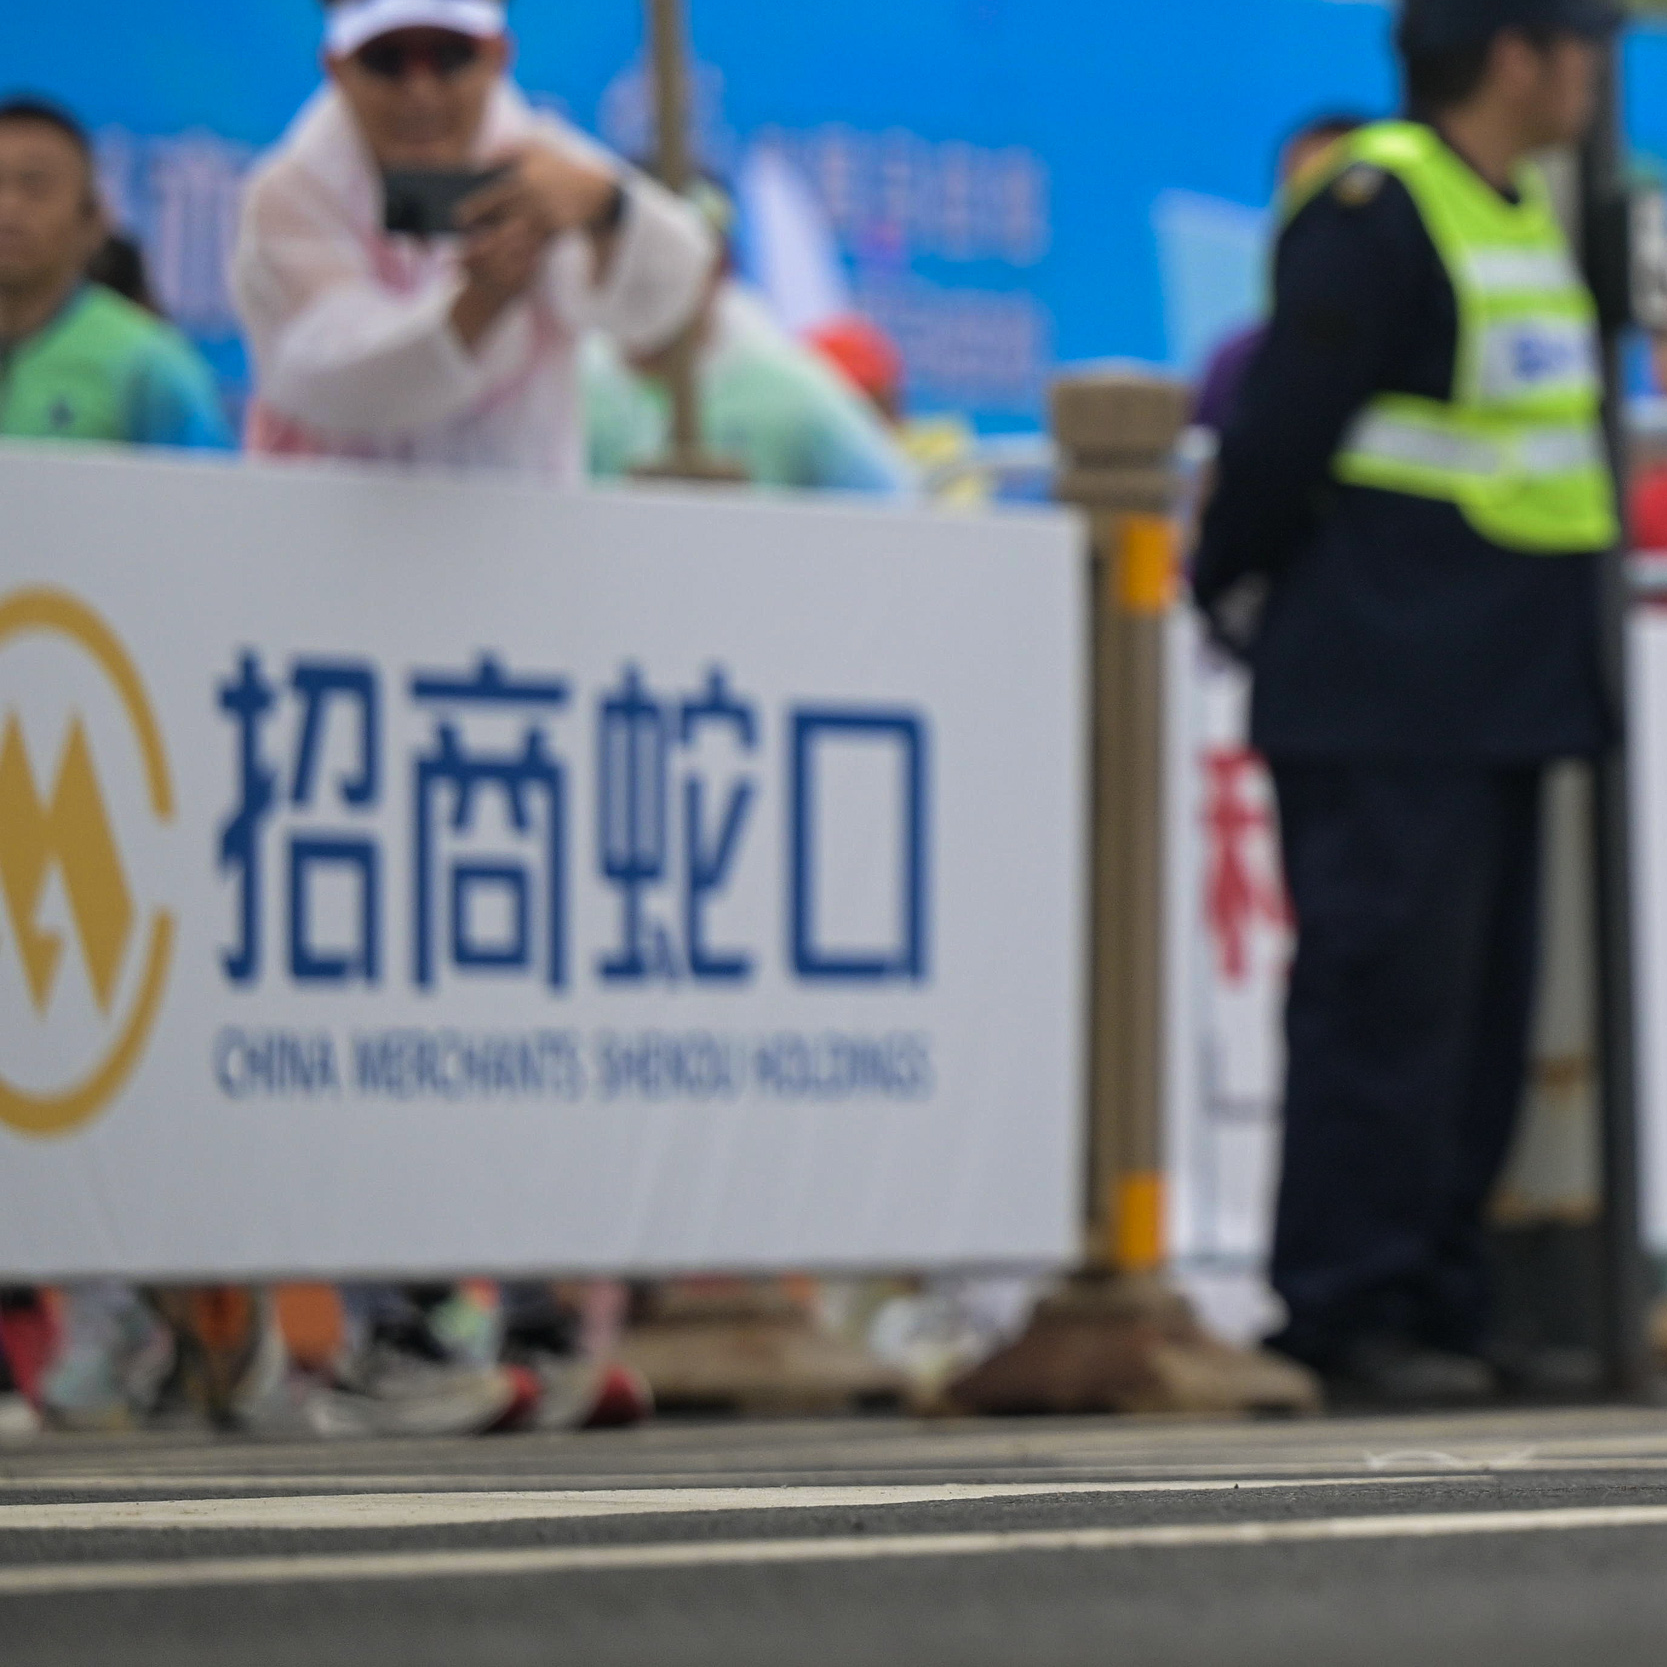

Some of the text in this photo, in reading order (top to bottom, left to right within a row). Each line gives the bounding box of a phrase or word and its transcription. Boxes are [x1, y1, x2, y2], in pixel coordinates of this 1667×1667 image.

[215, 645, 933, 993] 招商蛇口
[214, 1026, 339, 1100] CHINA
[353, 1026, 585, 1100] MERCHANTS
